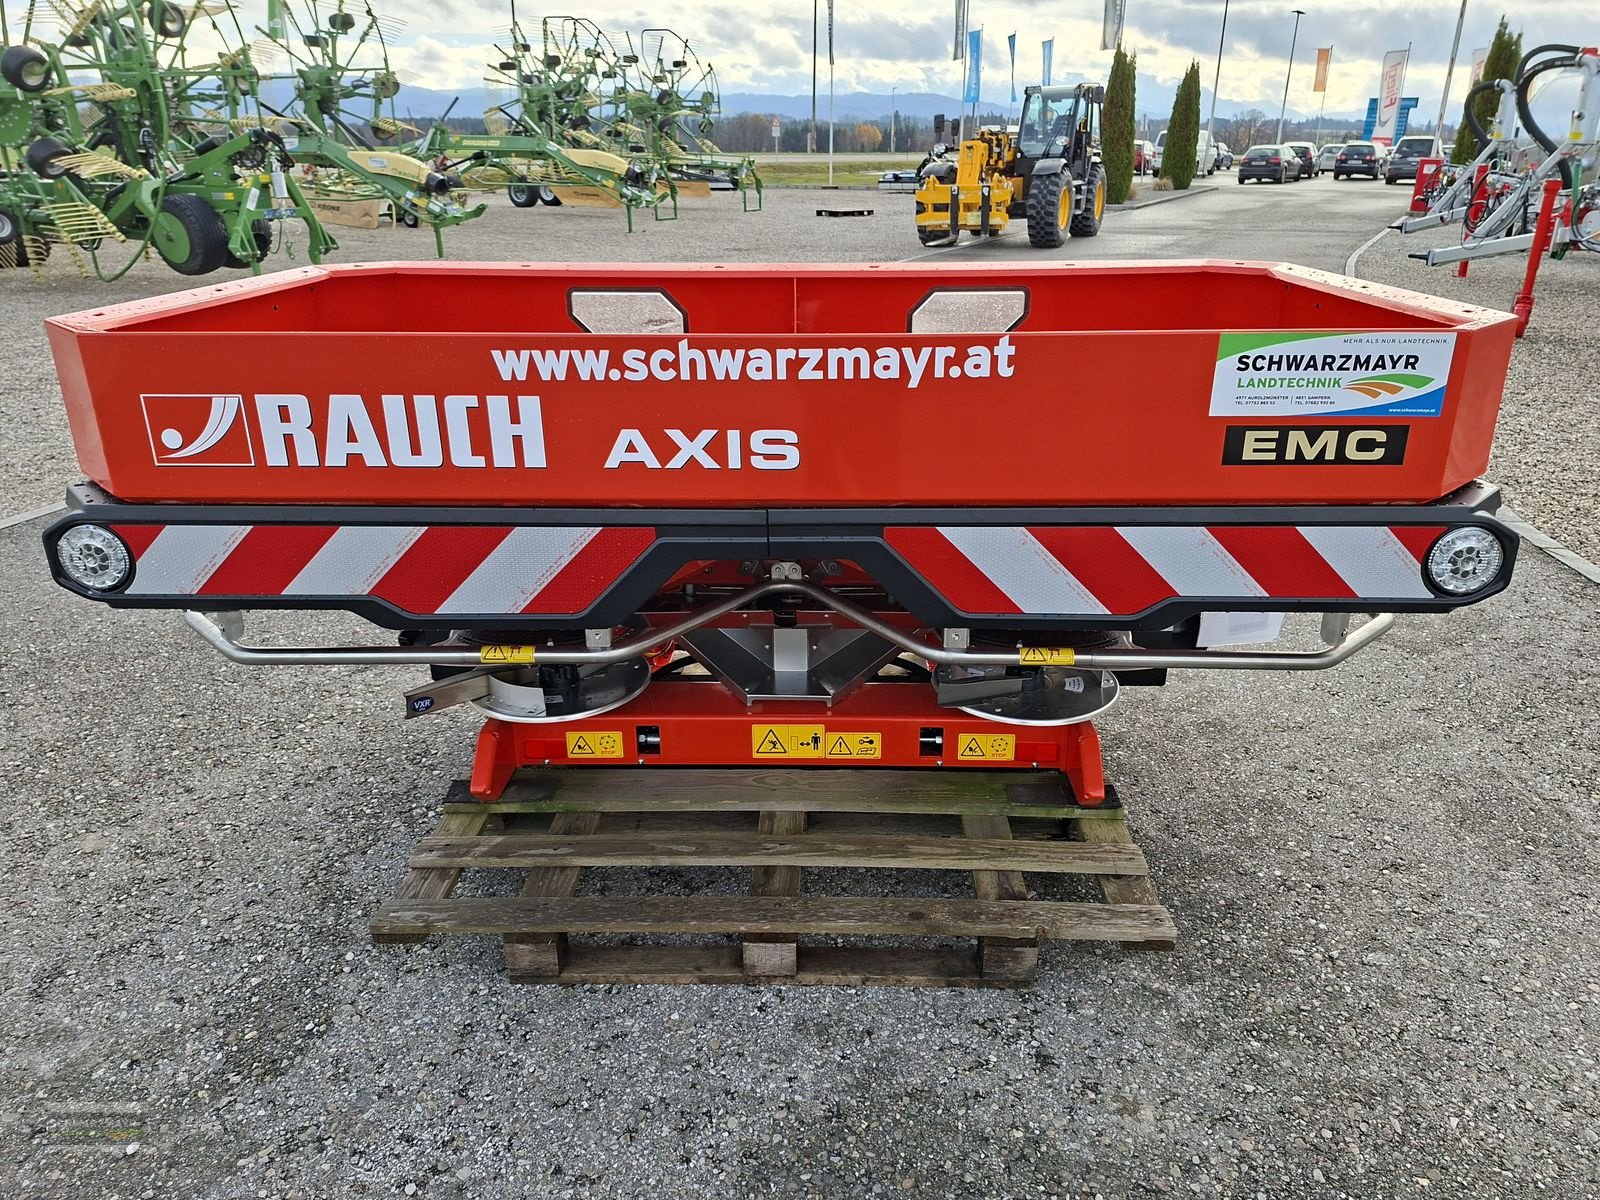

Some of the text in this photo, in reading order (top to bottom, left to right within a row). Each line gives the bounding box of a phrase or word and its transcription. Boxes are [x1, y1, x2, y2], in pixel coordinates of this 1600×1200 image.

[491, 335, 1016, 388] www.schwarzmayr.at
[1236, 354, 1420, 372] SCHWARZMAYR
[1237, 377, 1342, 389] LANDTECHNIK
[254, 394, 548, 468] RAUCH
[1242, 430, 1387, 461] EMC
[604, 429, 800, 469] AXIS
[414, 698, 431, 709] VXR
